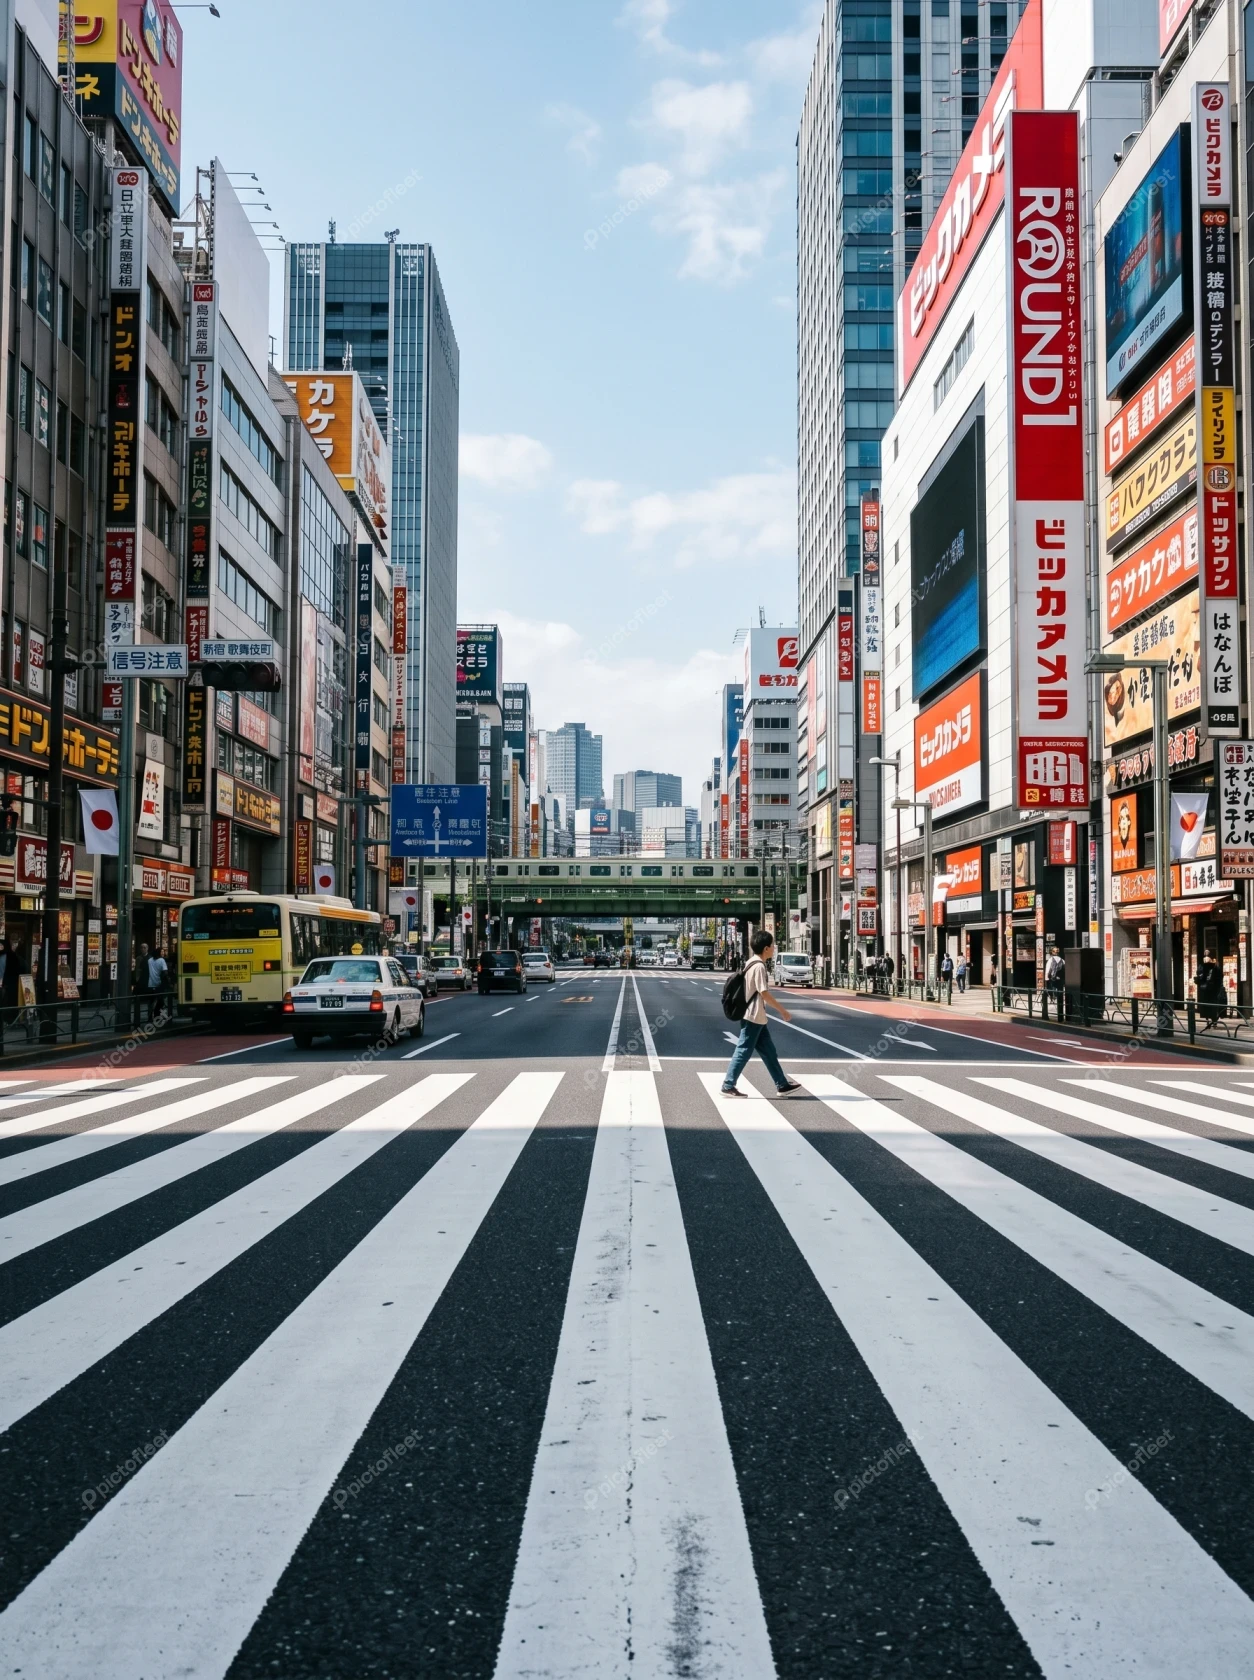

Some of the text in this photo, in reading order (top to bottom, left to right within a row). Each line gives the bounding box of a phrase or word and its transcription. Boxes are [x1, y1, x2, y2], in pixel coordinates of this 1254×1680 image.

[111, 651, 184, 670] 信号注意
[203, 643, 226, 656] 新宿
[1213, 612, 1233, 693] はなんぼ
[919, 703, 972, 769] ビックカメラ
